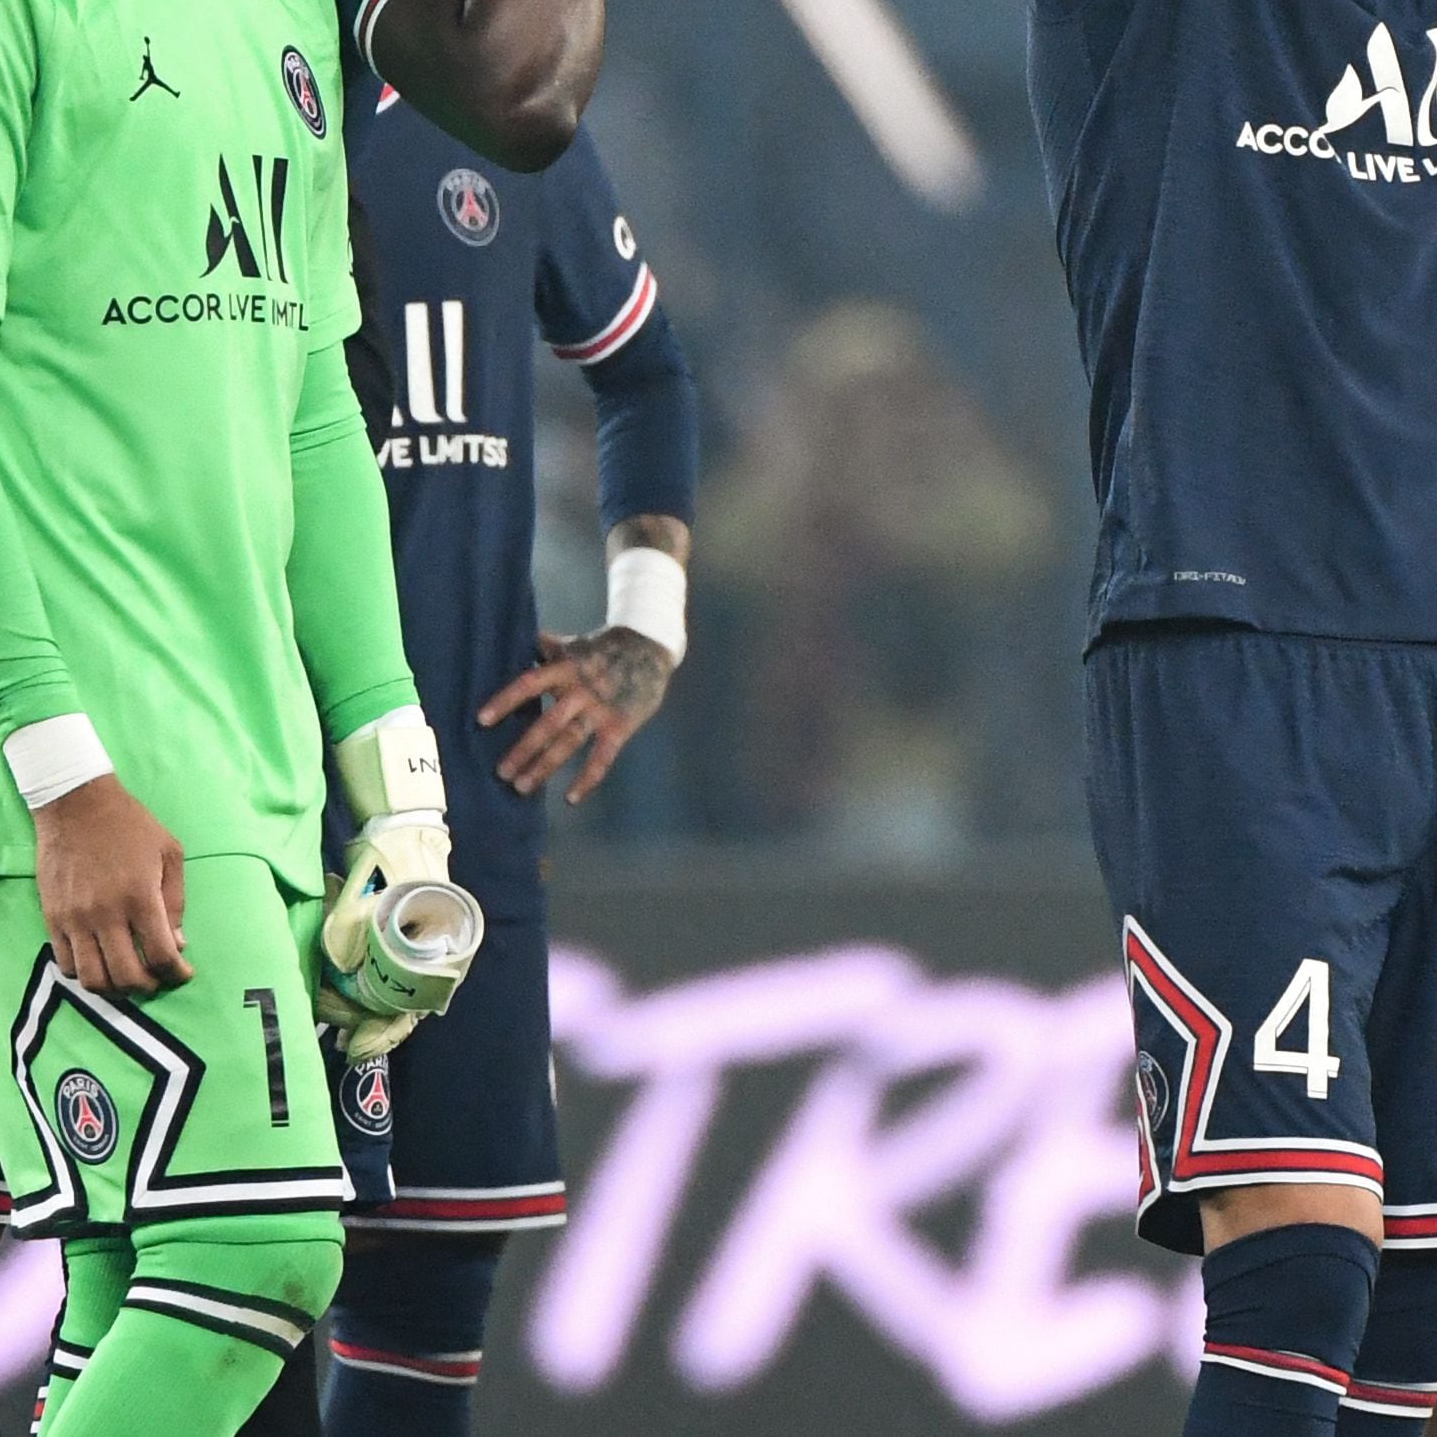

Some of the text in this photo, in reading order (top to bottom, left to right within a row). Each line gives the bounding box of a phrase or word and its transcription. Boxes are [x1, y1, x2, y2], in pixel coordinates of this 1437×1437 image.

[1236, 121, 1338, 161] ACCO
[1347, 151, 1421, 183] LIVE
[102, 293, 223, 326] ACCOR
[243, 988, 290, 1128] 1
[1253, 958, 1341, 1100] 4
[62, 1078, 99, 1099] PARIS
